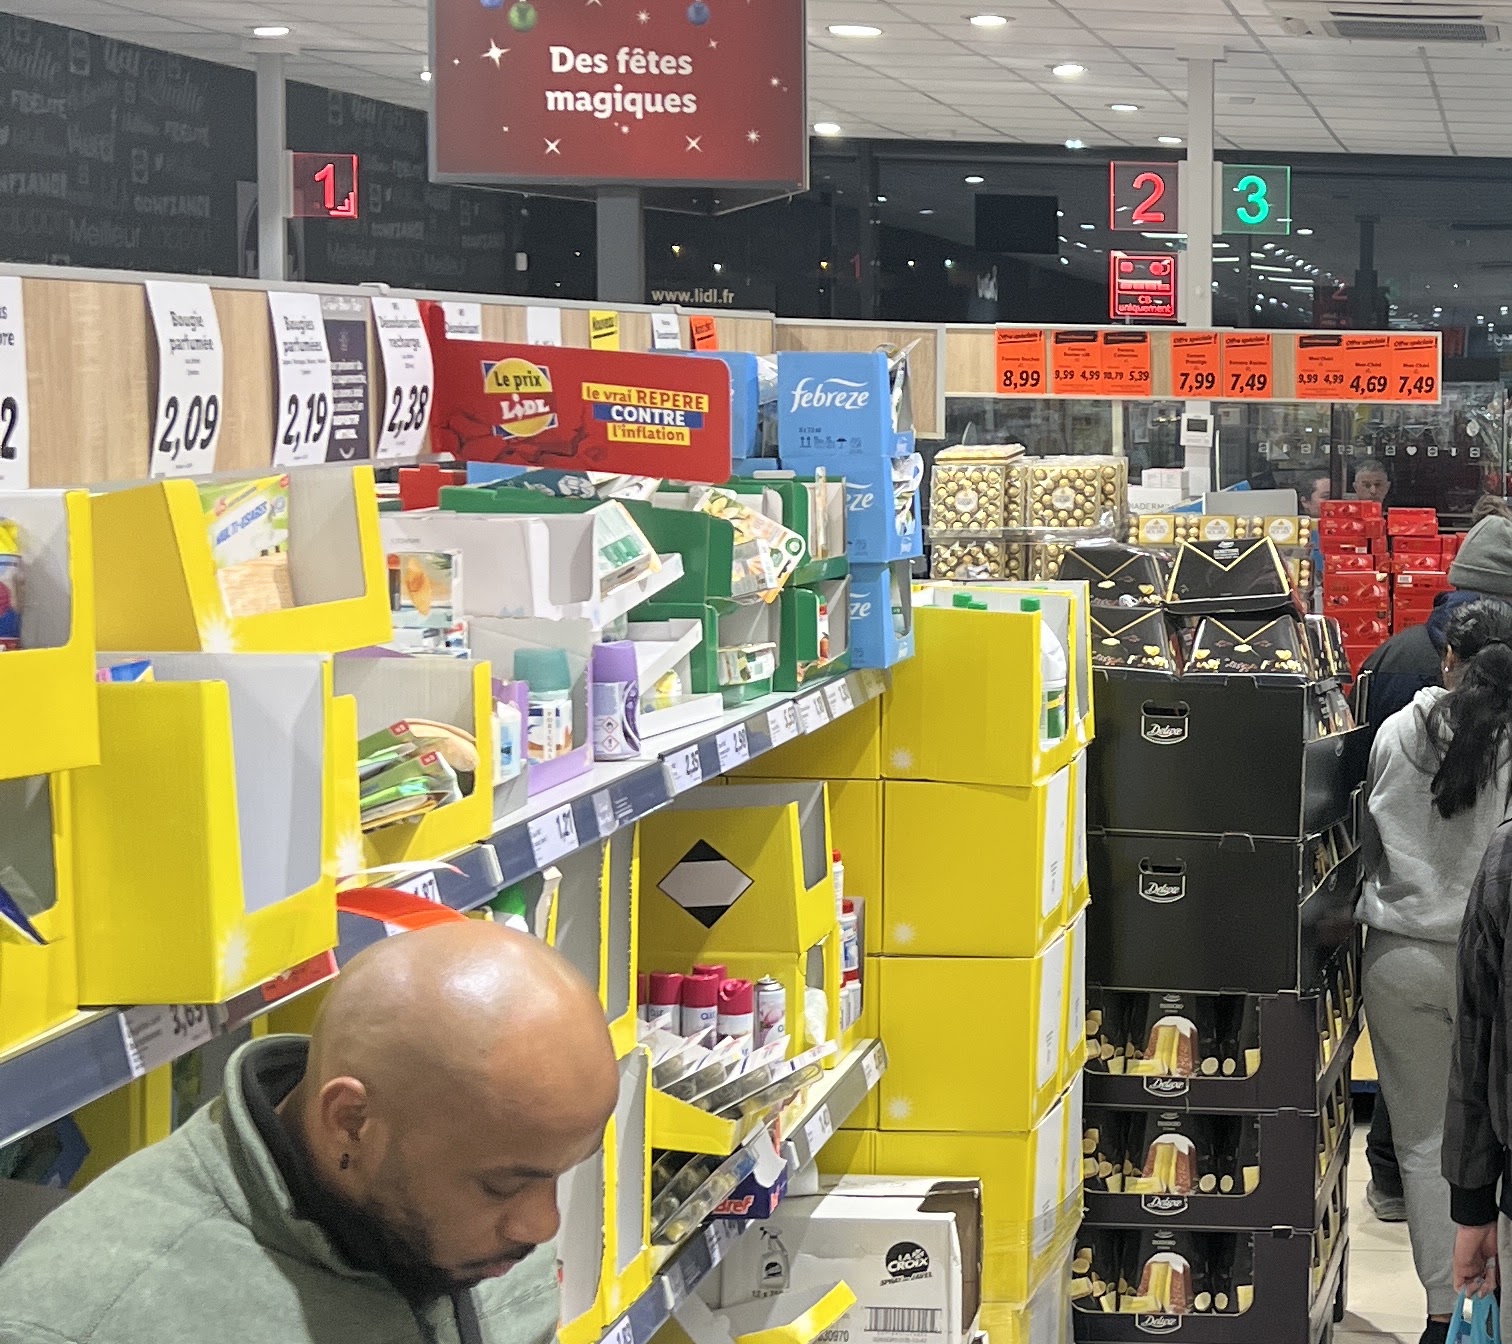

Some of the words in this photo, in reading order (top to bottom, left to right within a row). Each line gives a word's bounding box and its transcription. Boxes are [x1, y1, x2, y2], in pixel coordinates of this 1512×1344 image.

[549, 46, 609, 75] Des
[617, 46, 693, 76] fêtes
[545, 84, 697, 119] magiques
[314, 164, 334, 209] 1
[1132, 172, 1165, 222] 2
[1236, 175, 1269, 224] 3
[652, 289, 735, 304] www.lidl.fr
[1118, 304, 1172, 314] uniquement
[494, 370, 510, 387] Le
[513, 370, 542, 391] prix
[1003, 370, 1040, 389] 8,99
[1179, 372, 1215, 392] 7,99
[1231, 373, 1267, 392] 7,49
[1350, 375, 1387, 393] 4,69
[1399, 375, 1434, 394] 7,49
[586, 386, 600, 401] le
[602, 389, 632, 403] vrai
[790, 377, 870, 413] febreze
[388, 385, 430, 439] 2,38
[610, 406, 686, 426] CONTRE
[159, 394, 219, 461] 2,09
[282, 392, 327, 452] 2,19
[612, 425, 686, 442] l'inflation
[1147, 723, 1183, 738] Deluxe
[1144, 882, 1180, 897] Deluxe
[1151, 1078, 1185, 1092] Deluxe
[1150, 1195, 1184, 1210] Deluxe
[887, 1257, 929, 1273] CROIX
[1143, 1313, 1178, 1328] Deluxe
